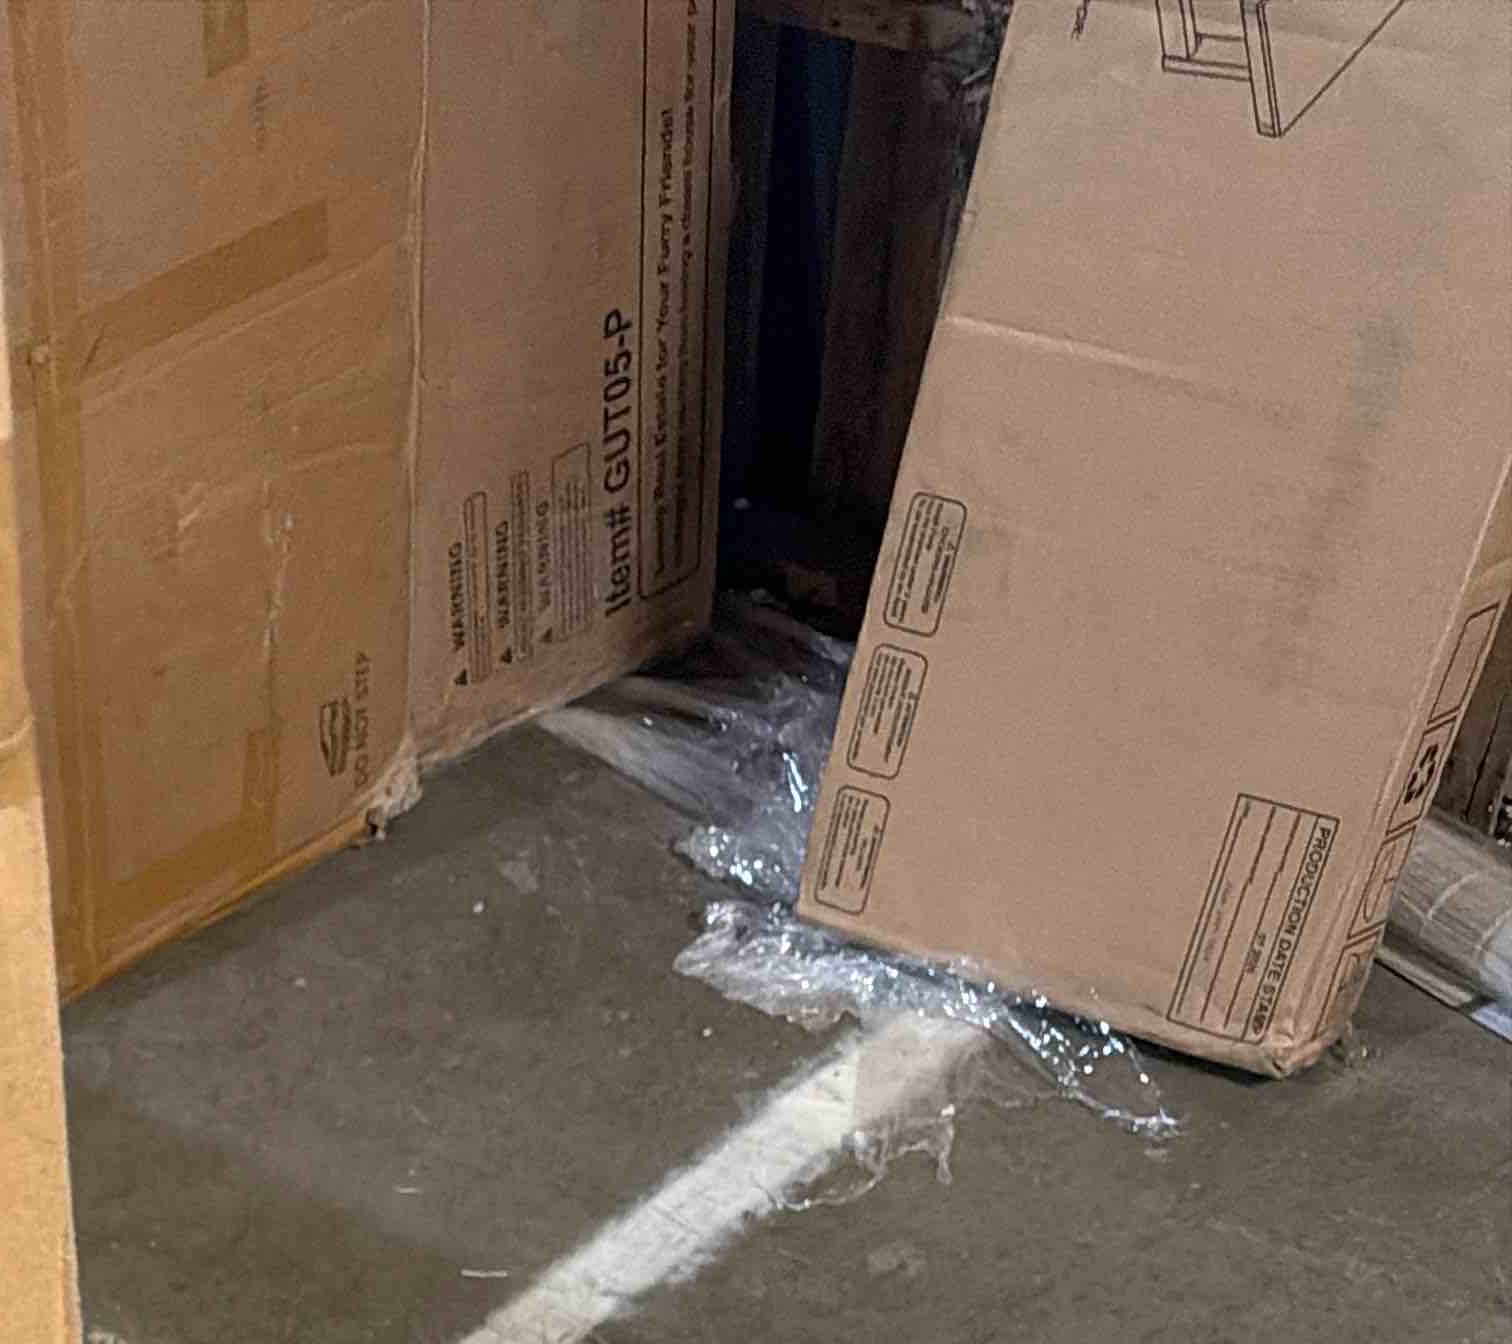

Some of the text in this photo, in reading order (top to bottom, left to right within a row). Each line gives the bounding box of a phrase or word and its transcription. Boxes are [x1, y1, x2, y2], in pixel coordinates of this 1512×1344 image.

[603, 308, 633, 618] Item# GUT05-P
[448, 541, 466, 653] WARNING
[495, 520, 511, 628] WARNING
[1286, 826, 1331, 937] PRODUCTION
[1266, 938, 1293, 982] DATE
